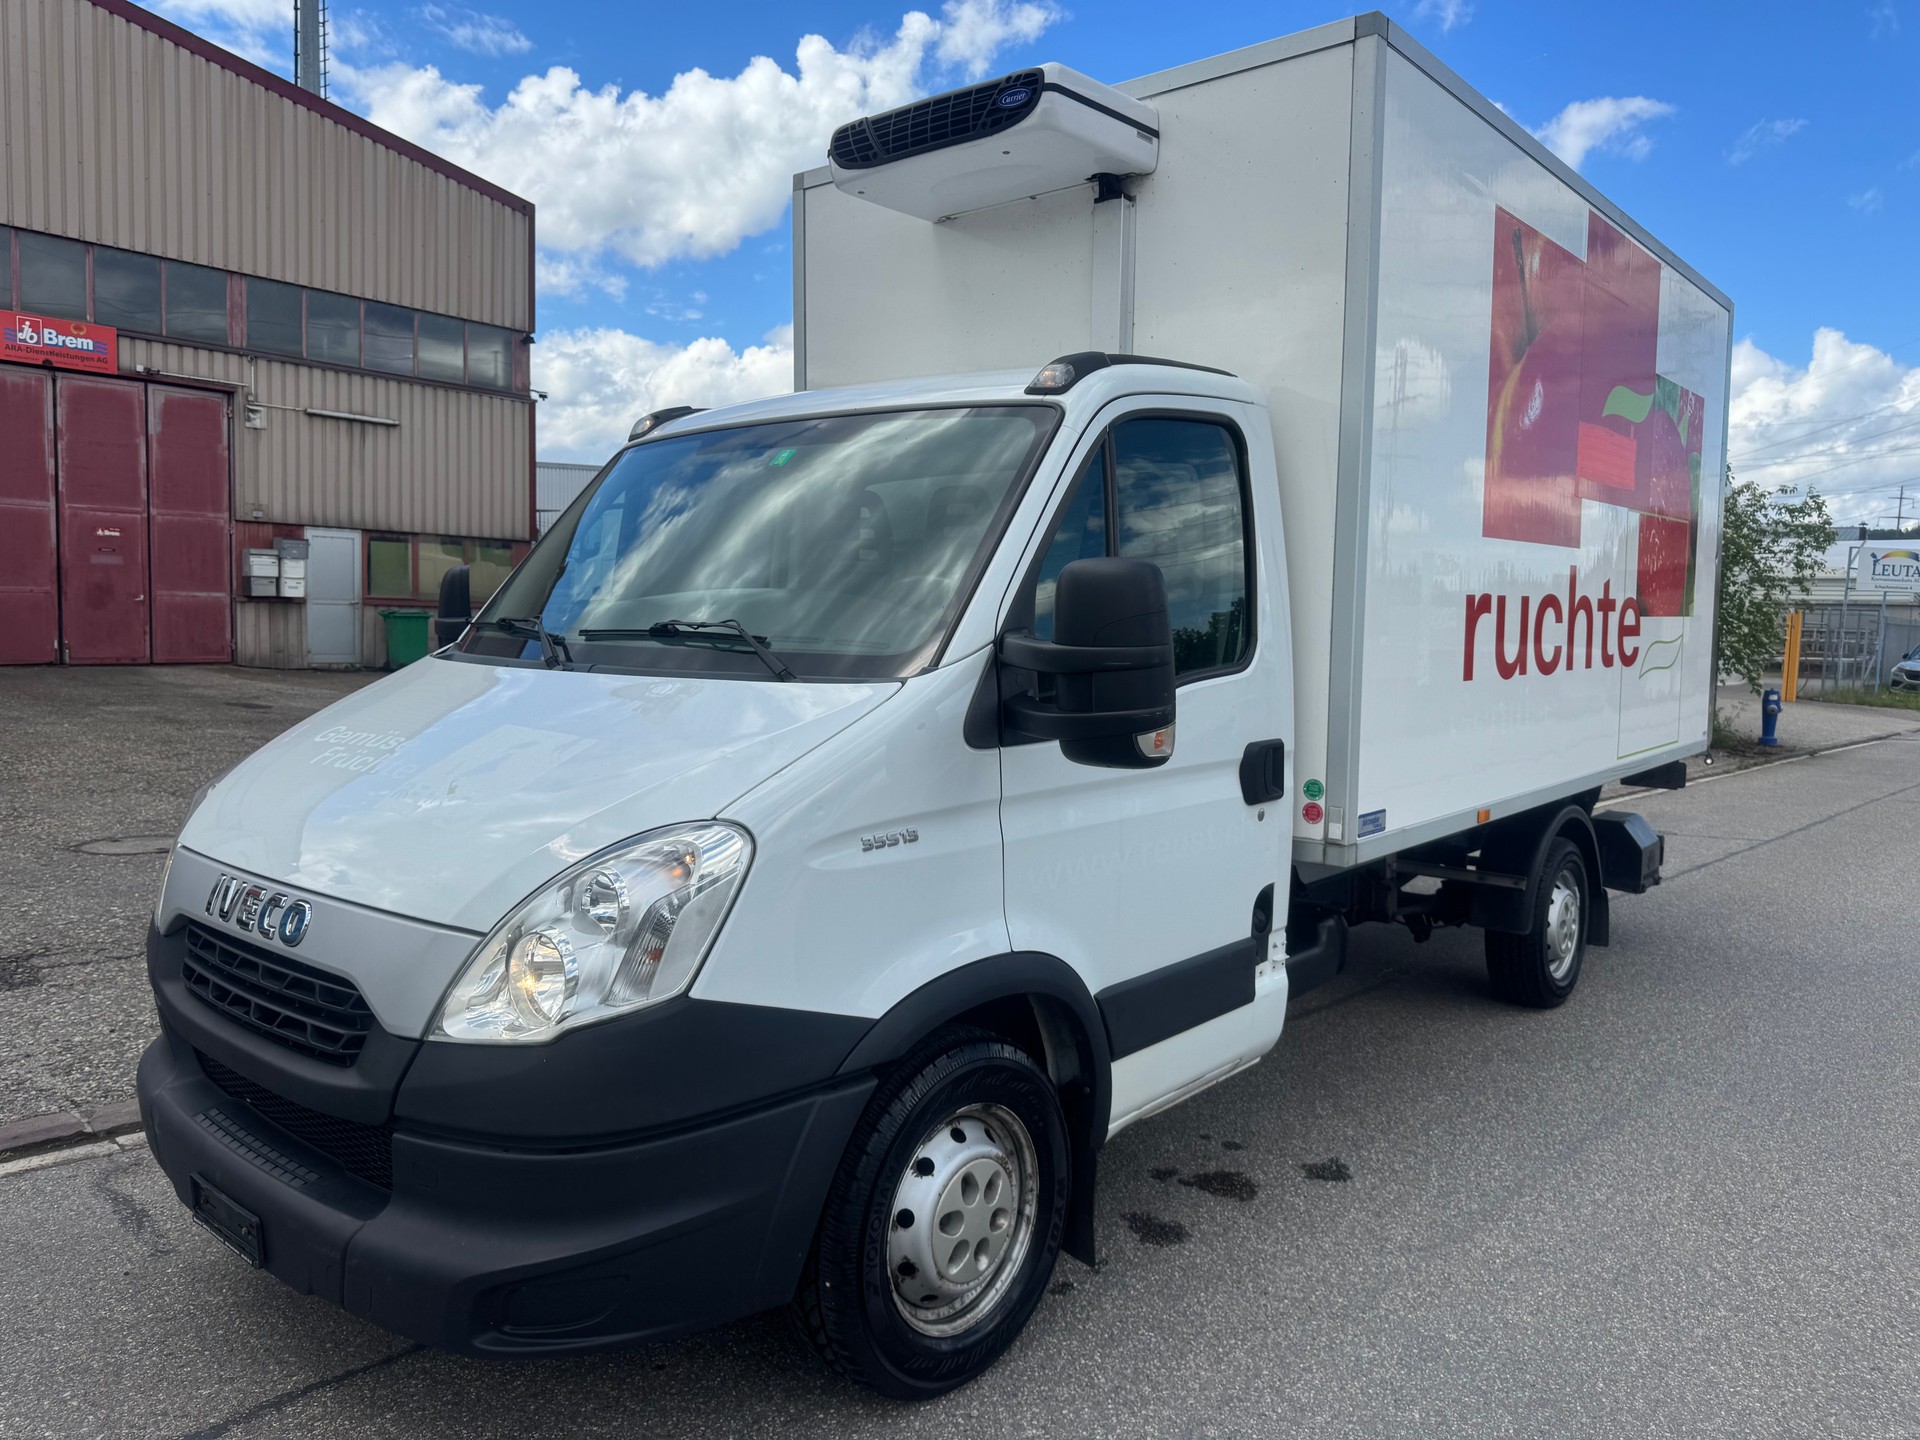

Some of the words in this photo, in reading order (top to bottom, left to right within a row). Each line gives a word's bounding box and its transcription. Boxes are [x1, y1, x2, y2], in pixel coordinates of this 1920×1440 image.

[1001, 92, 1027, 104] Carrier
[43, 327, 94, 351] Brem
[4, 343, 95, 363] ARA-Dienstleistungen
[96, 356, 109, 365] AG
[1463, 565, 1641, 681] ruchte
[860, 828, 920, 853] 35S13
[205, 872, 313, 948] IVECO
